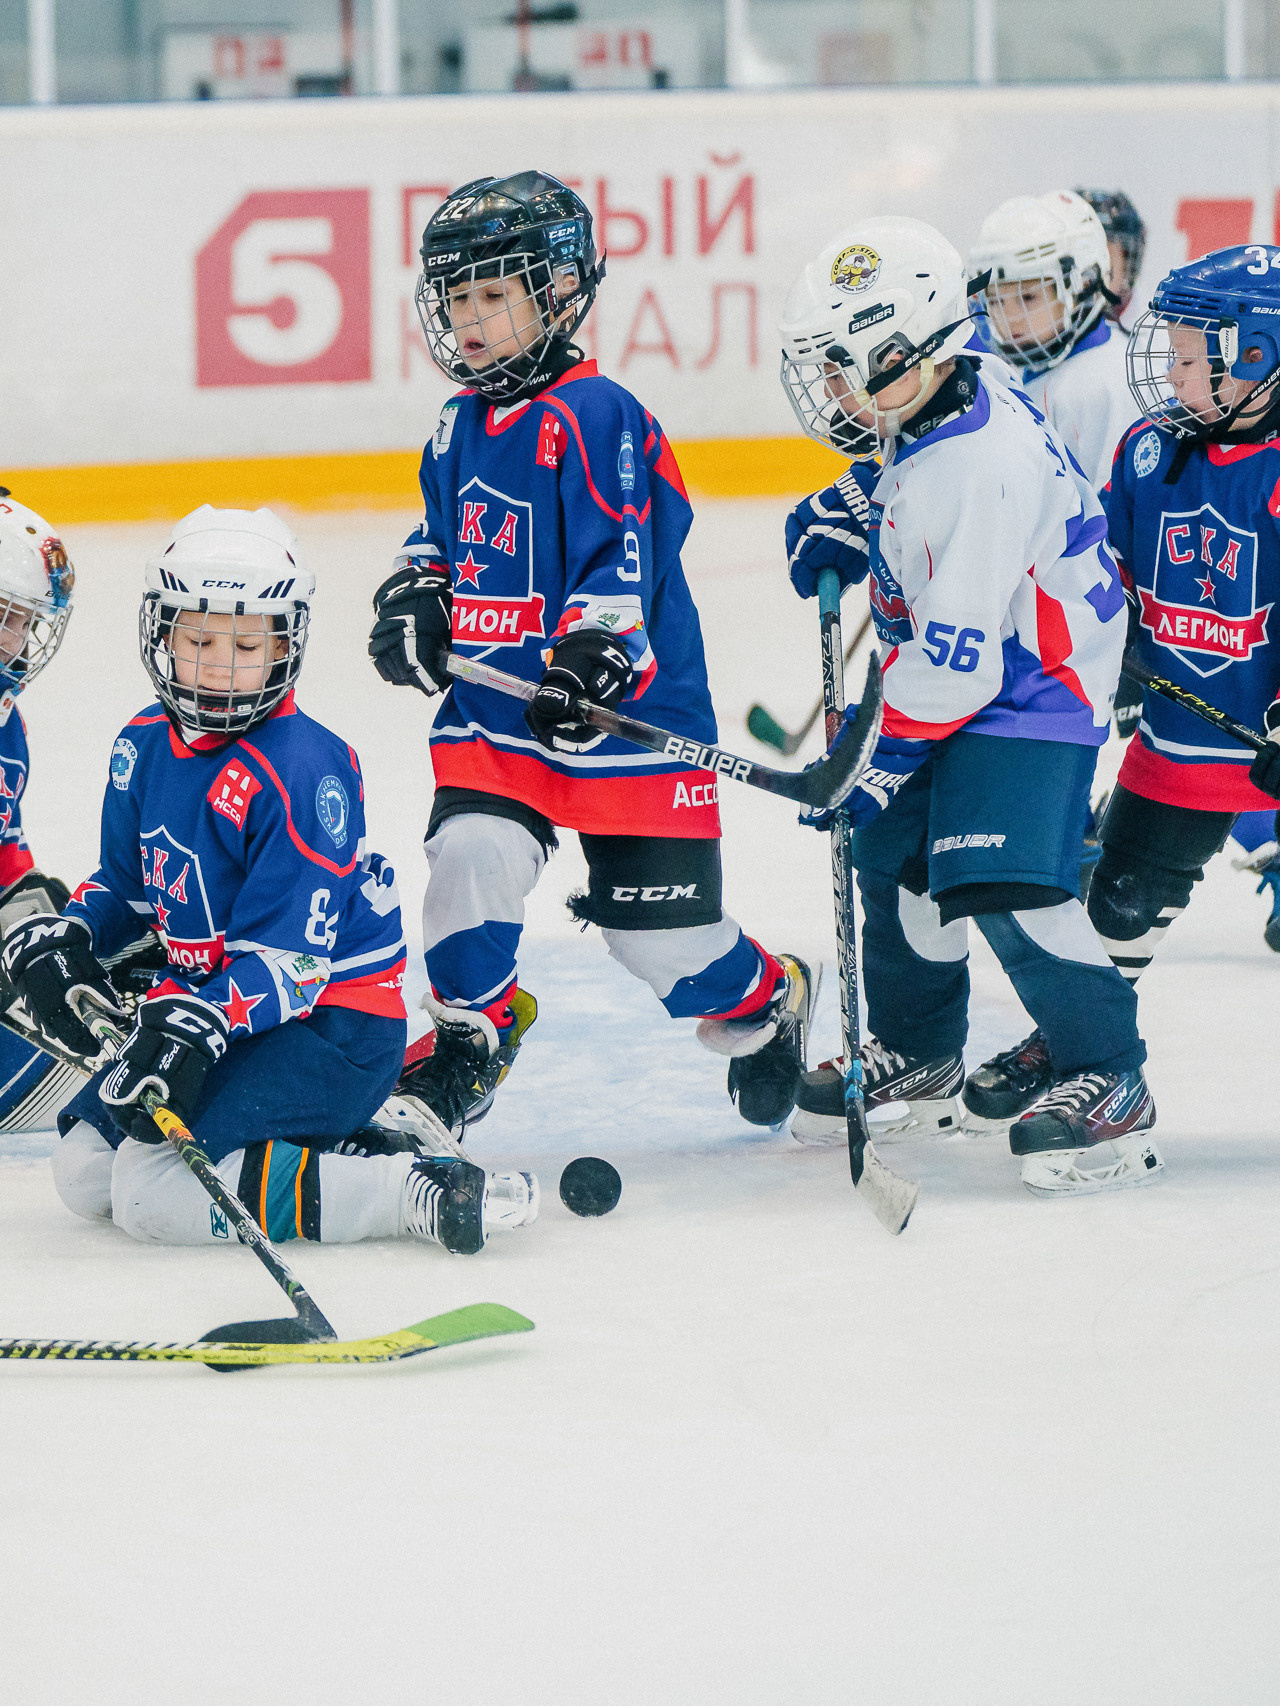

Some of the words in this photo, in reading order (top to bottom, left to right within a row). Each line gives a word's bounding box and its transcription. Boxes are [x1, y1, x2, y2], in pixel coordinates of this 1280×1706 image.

[437, 196, 477, 221] 22
[548, 226, 576, 240] CCM
[427, 252, 461, 267] CCM
[226, 216, 344, 367] 5
[565, 293, 582, 309] CCM
[851, 307, 893, 332] BAUER
[458, 501, 519, 557] КА
[1166, 523, 1242, 582] СКА
[201, 579, 247, 591] CCM
[452, 608, 522, 635] ГИОН
[1157, 612, 1246, 651] ЛЕГИОН
[922, 620, 986, 673] 56
[537, 690, 565, 701] CCM
[1157, 679, 1225, 719] ALPHA
[663, 736, 753, 783] BAUER
[931, 834, 1006, 855] BAUER
[611, 883, 701, 903] CCM
[888, 1069, 929, 1098] CCM
[1103, 1086, 1129, 1119] CCM
